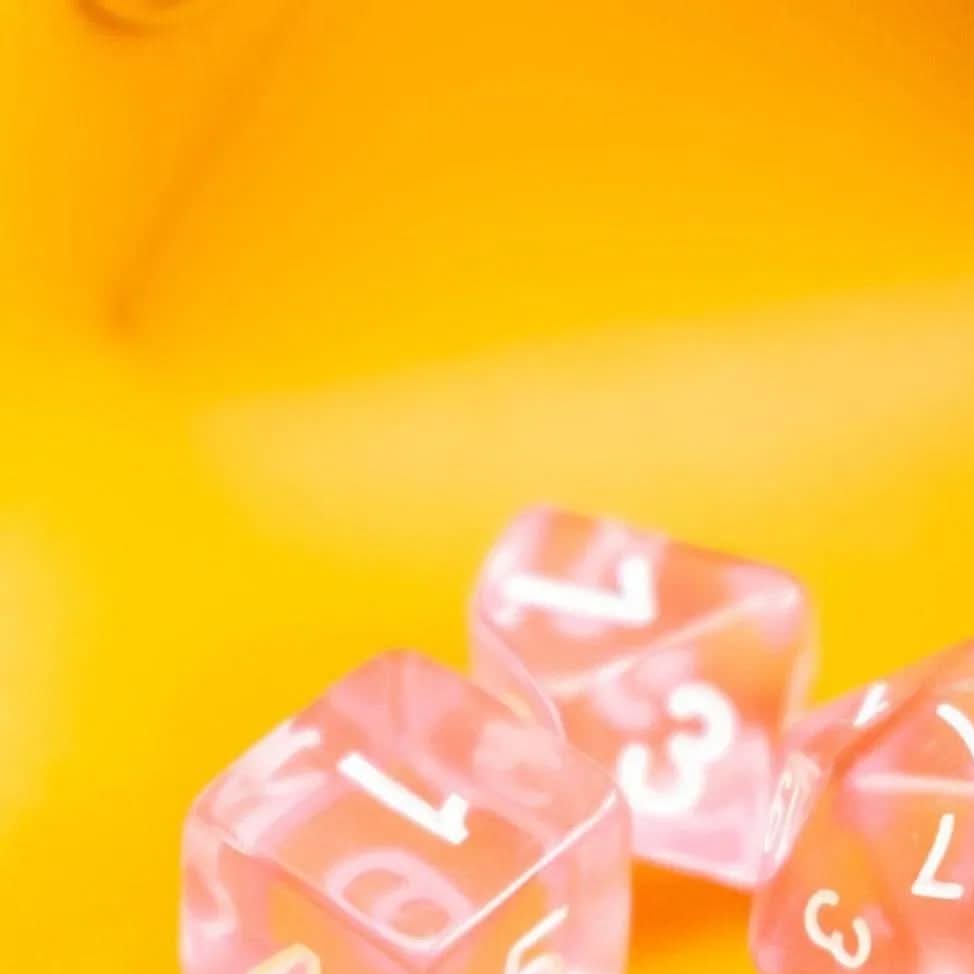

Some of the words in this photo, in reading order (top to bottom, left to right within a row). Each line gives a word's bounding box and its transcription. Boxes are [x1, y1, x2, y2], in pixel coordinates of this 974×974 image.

[617, 683, 735, 814] 3
[853, 681, 889, 729] 1
[338, 752, 468, 845] 1
[804, 889, 872, 970] 3
